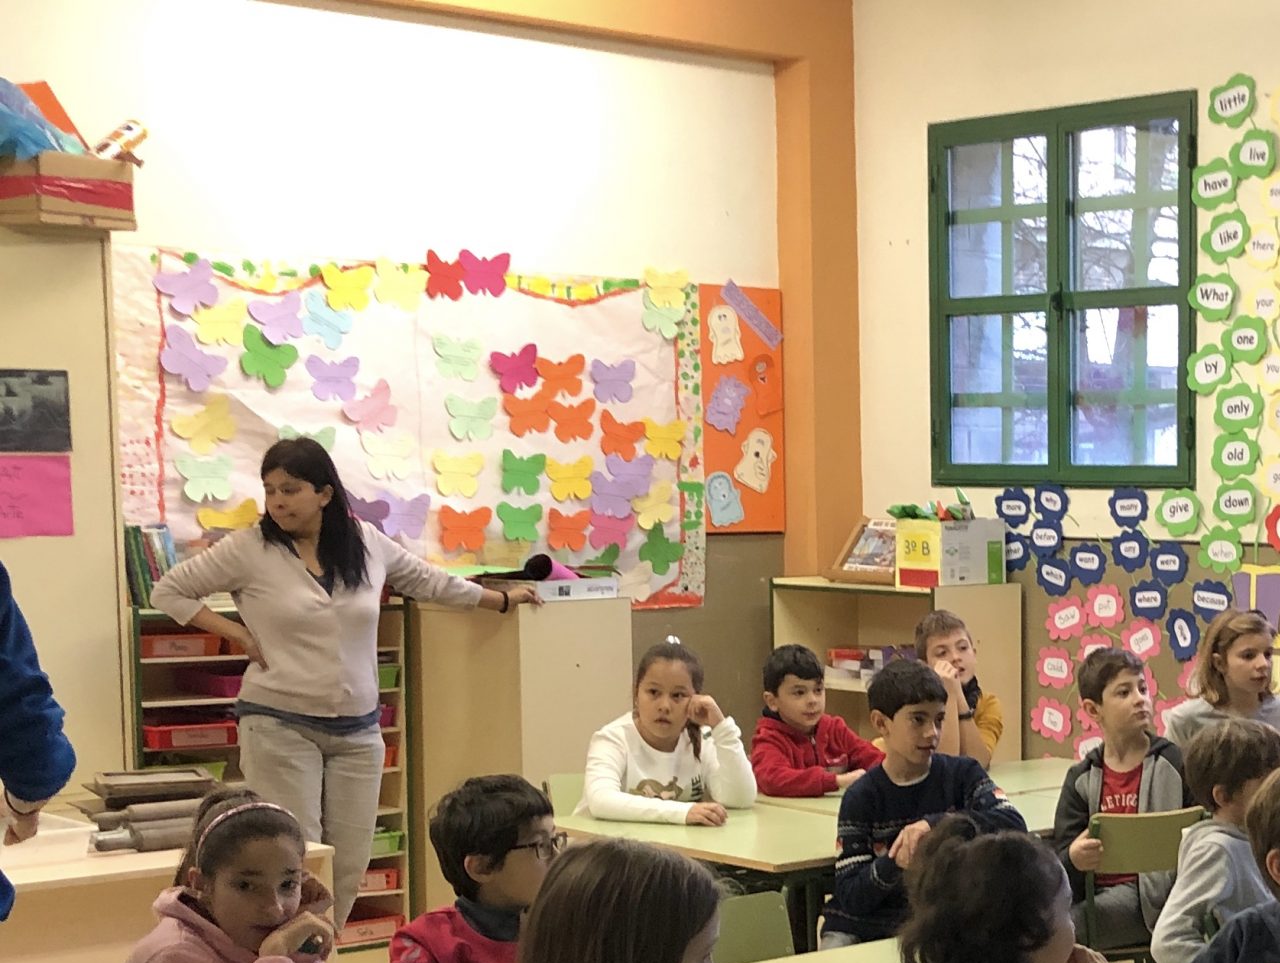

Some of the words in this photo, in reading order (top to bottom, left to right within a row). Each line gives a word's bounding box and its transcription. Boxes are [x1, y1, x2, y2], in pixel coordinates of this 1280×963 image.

[1219, 92, 1246, 112] little
[1250, 148, 1266, 161] live
[1203, 177, 1228, 192] have
[1219, 229, 1239, 246] like
[1252, 239, 1274, 251] there
[1200, 287, 1229, 302] What
[1236, 334, 1255, 345] one
[1205, 360, 1218, 374] by
[1266, 363, 1280, 374] you
[1227, 402, 1250, 417] only
[1227, 449, 1244, 461] old
[1006, 503, 1022, 511] more
[1119, 503, 1138, 513] many
[1224, 496, 1249, 508] down
[1169, 501, 1189, 517] give
[1035, 533, 1056, 542] before
[922, 540, 930, 556] B
[1212, 542, 1234, 559] when
[1160, 557, 1177, 566] were
[1137, 594, 1158, 603] where
[1196, 594, 1225, 606] because
